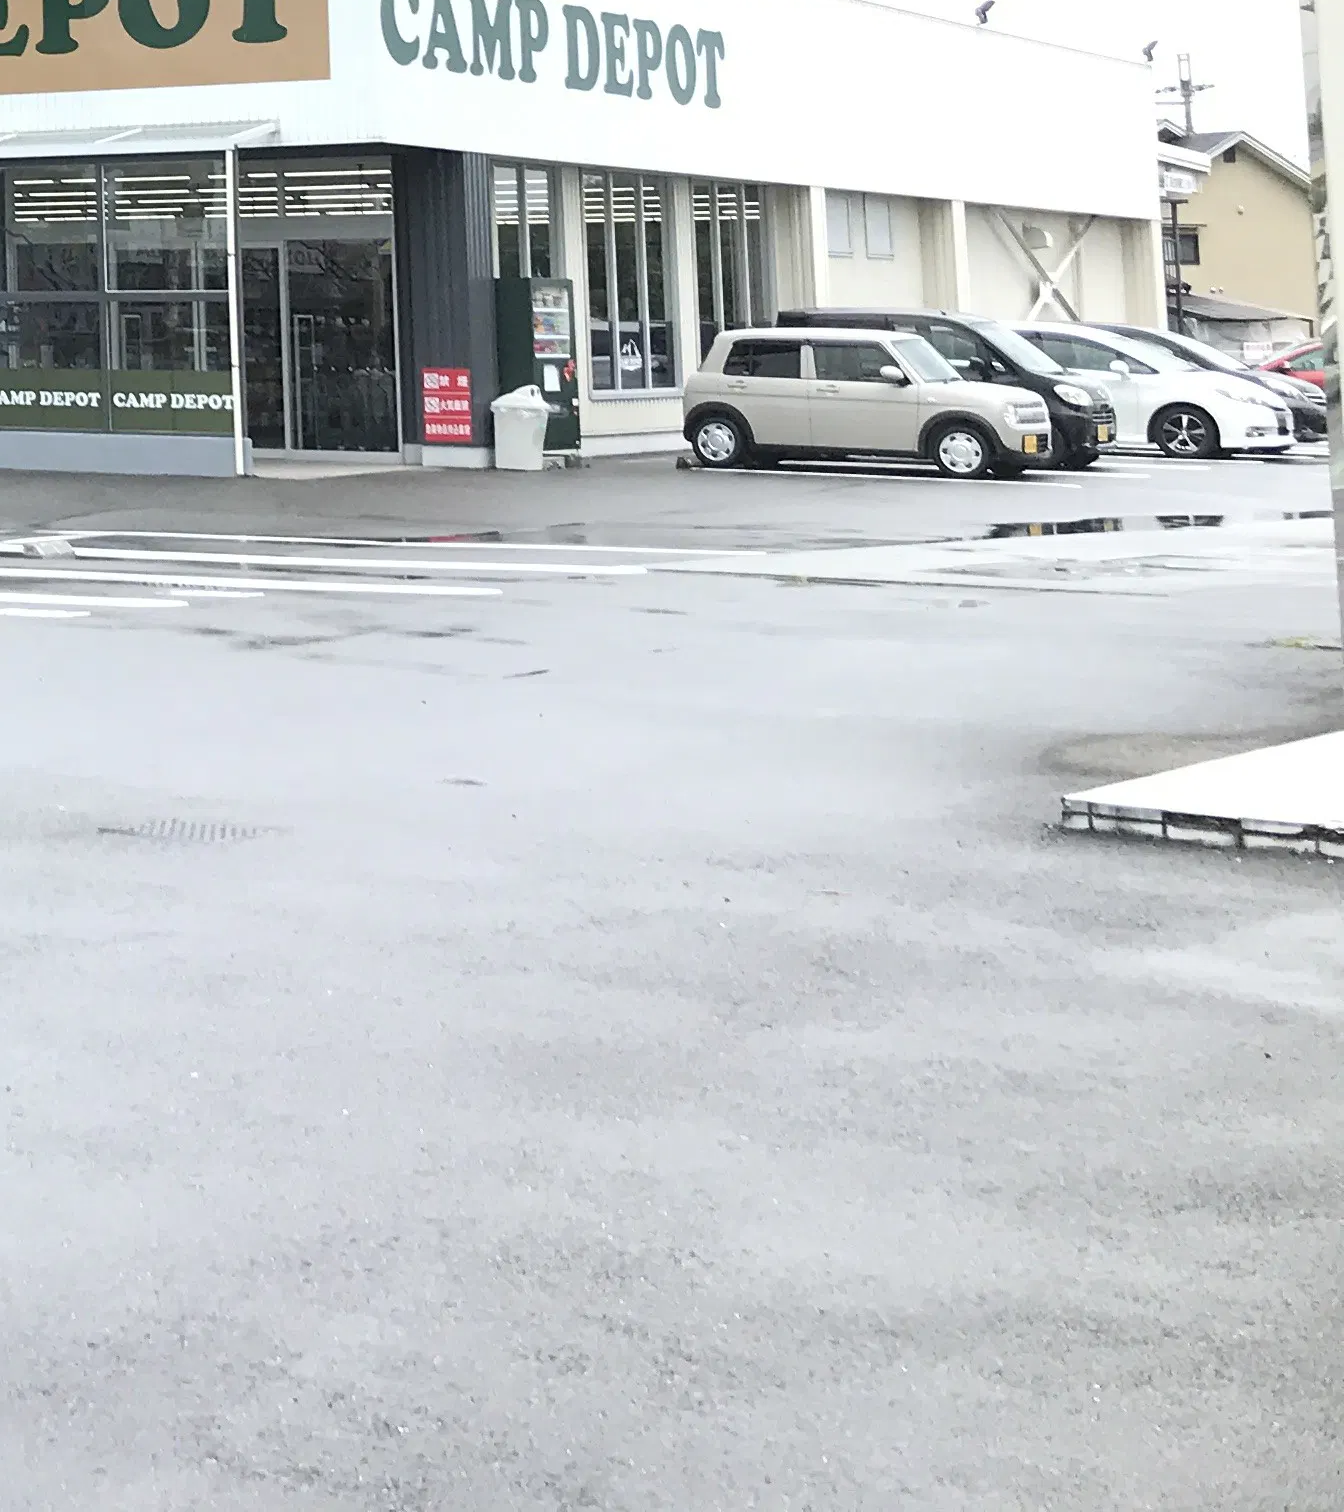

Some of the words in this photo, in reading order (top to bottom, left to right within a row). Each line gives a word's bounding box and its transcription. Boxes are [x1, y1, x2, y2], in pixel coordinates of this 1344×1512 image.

[562, 4, 725, 108] DEPOT
[39, 391, 101, 408] DEPOT
[113, 392, 167, 409] CAMP
[170, 393, 234, 410] DEPOT
